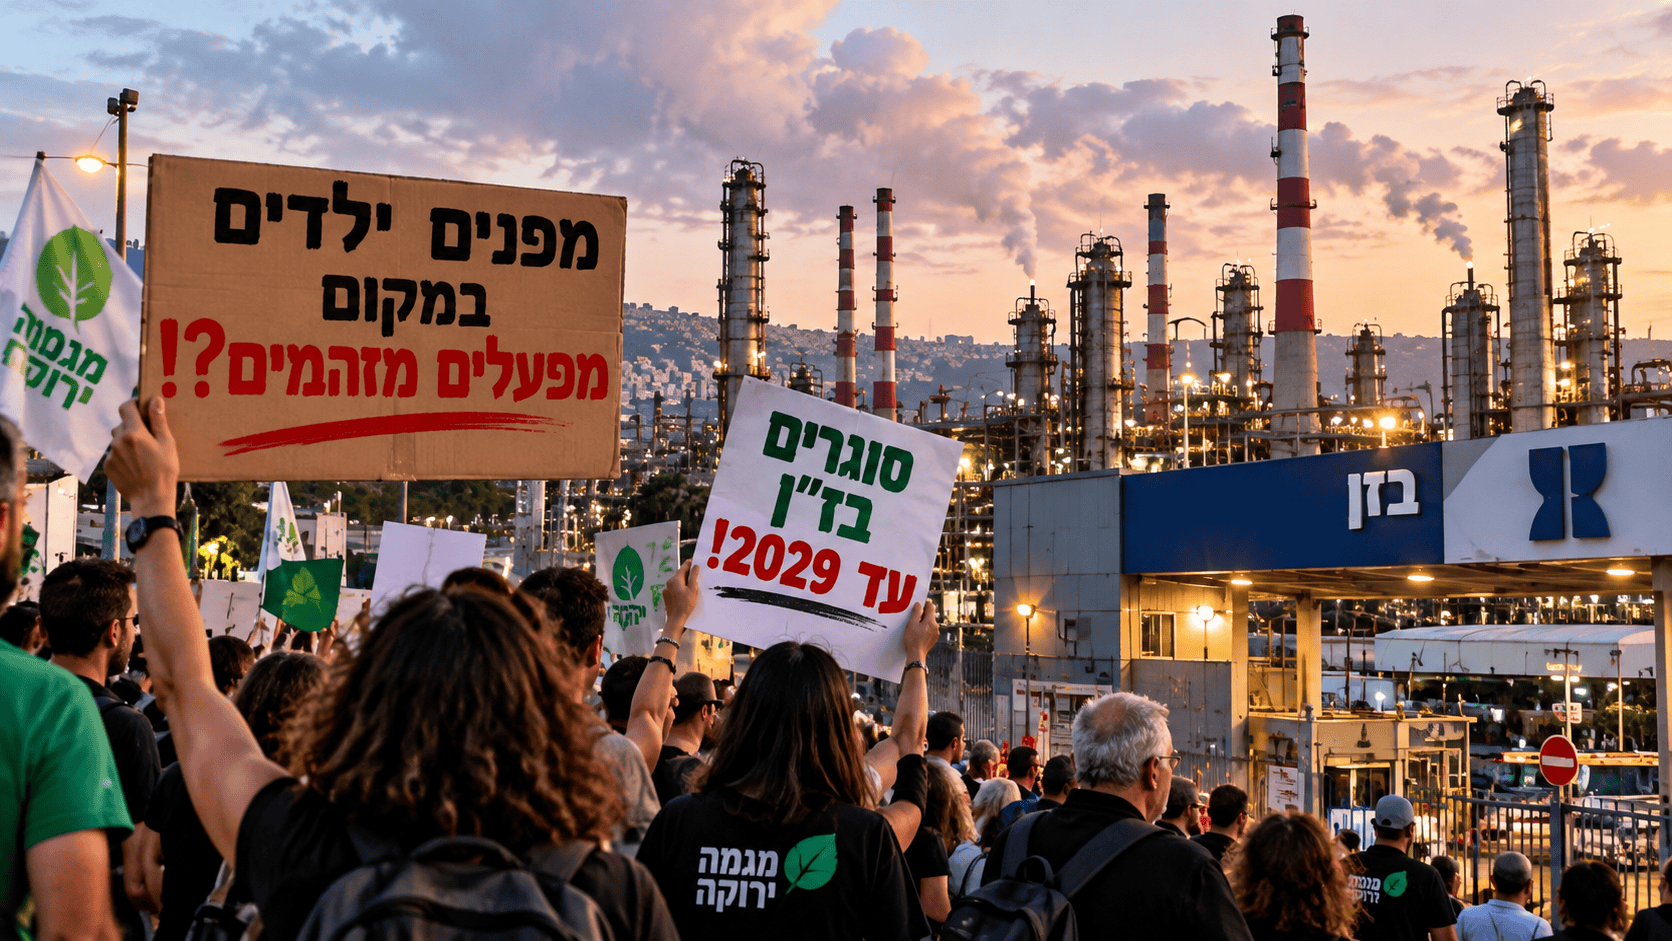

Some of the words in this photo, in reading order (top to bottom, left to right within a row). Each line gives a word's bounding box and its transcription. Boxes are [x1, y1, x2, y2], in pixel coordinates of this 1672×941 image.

[213, 180, 393, 253] ילדים
[429, 207, 600, 271] מפנים
[321, 274, 491, 337] במקום
[159, 317, 419, 399] מזהמים?!
[436, 334, 609, 403] מפעלים
[762, 410, 914, 493] סוגרים
[1347, 468, 1420, 530] בזן
[706, 517, 841, 595] 2029!
[858, 560, 918, 614] עד
[698, 846, 779, 877] מגמה
[695, 878, 776, 913] ירוקה
